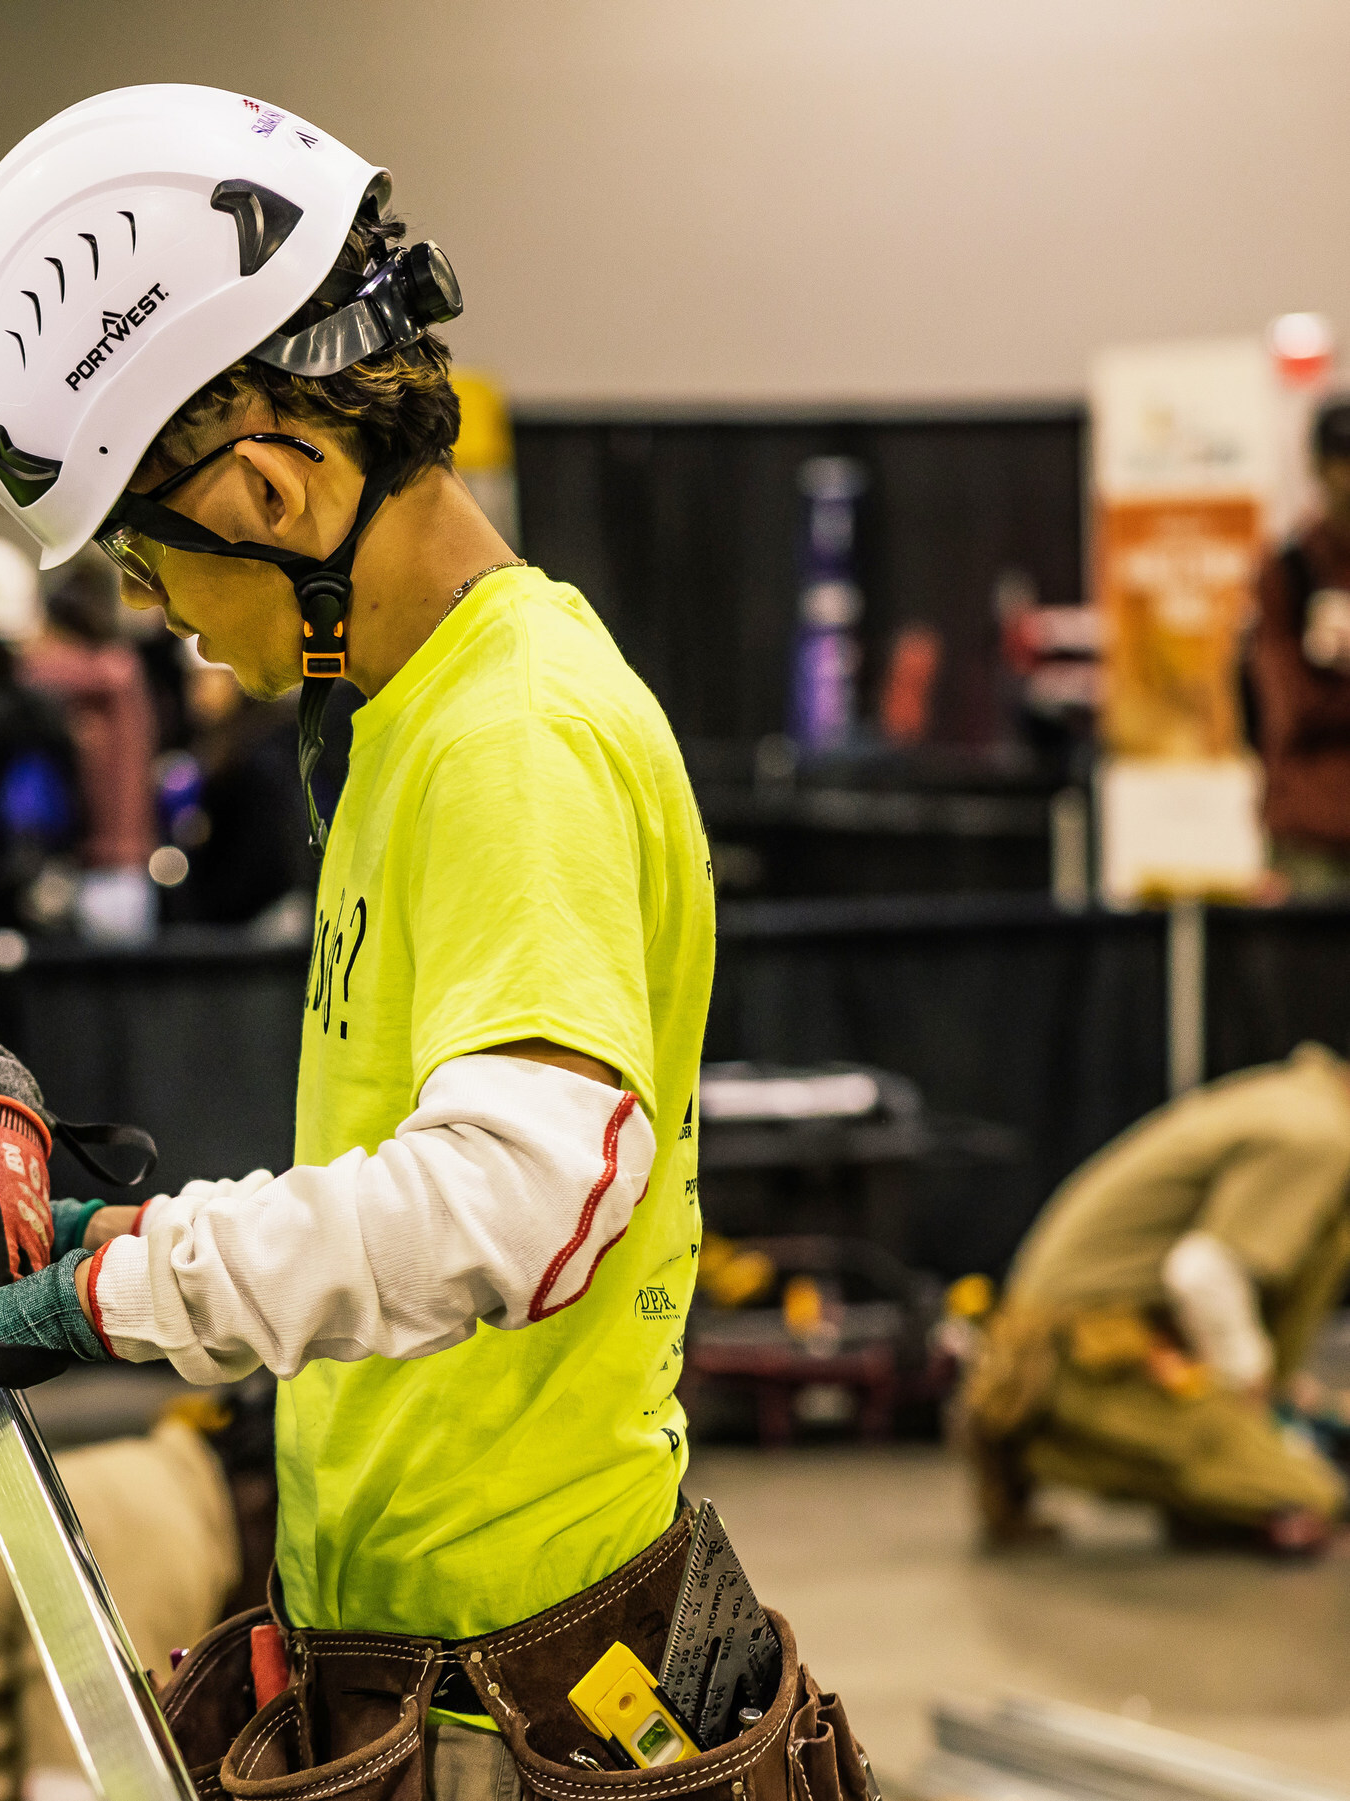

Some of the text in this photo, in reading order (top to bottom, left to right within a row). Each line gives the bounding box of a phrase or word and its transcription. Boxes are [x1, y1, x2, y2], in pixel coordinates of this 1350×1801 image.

[706, 1574, 727, 1630] COMMON
[720, 1595, 744, 1661] TOP CUTS
